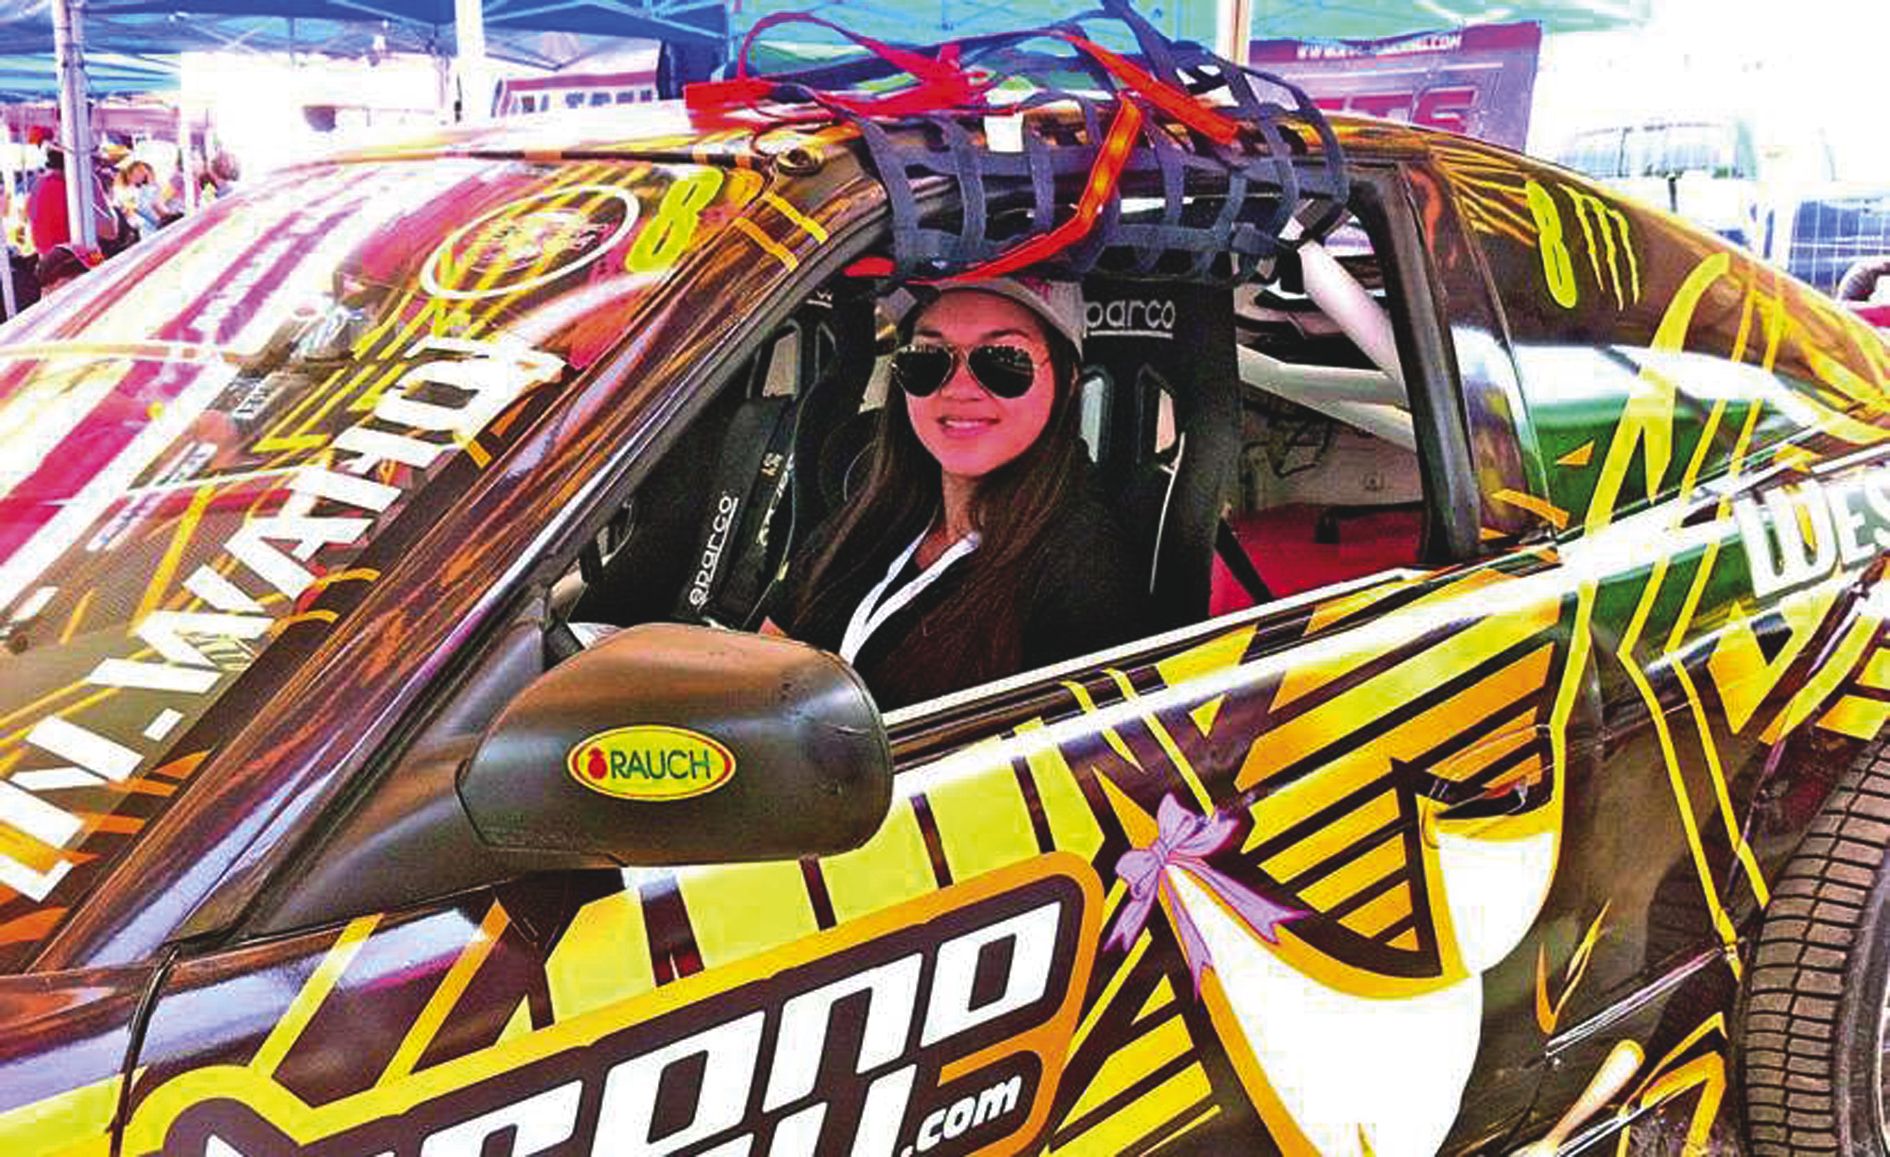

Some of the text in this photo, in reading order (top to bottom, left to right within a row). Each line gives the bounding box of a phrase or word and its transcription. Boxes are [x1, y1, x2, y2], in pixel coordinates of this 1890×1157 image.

[626, 165, 723, 273] 8
[1525, 180, 1577, 308] 8
[1083, 301, 1175, 338] parco
[609, 750, 712, 780] RAUCH
